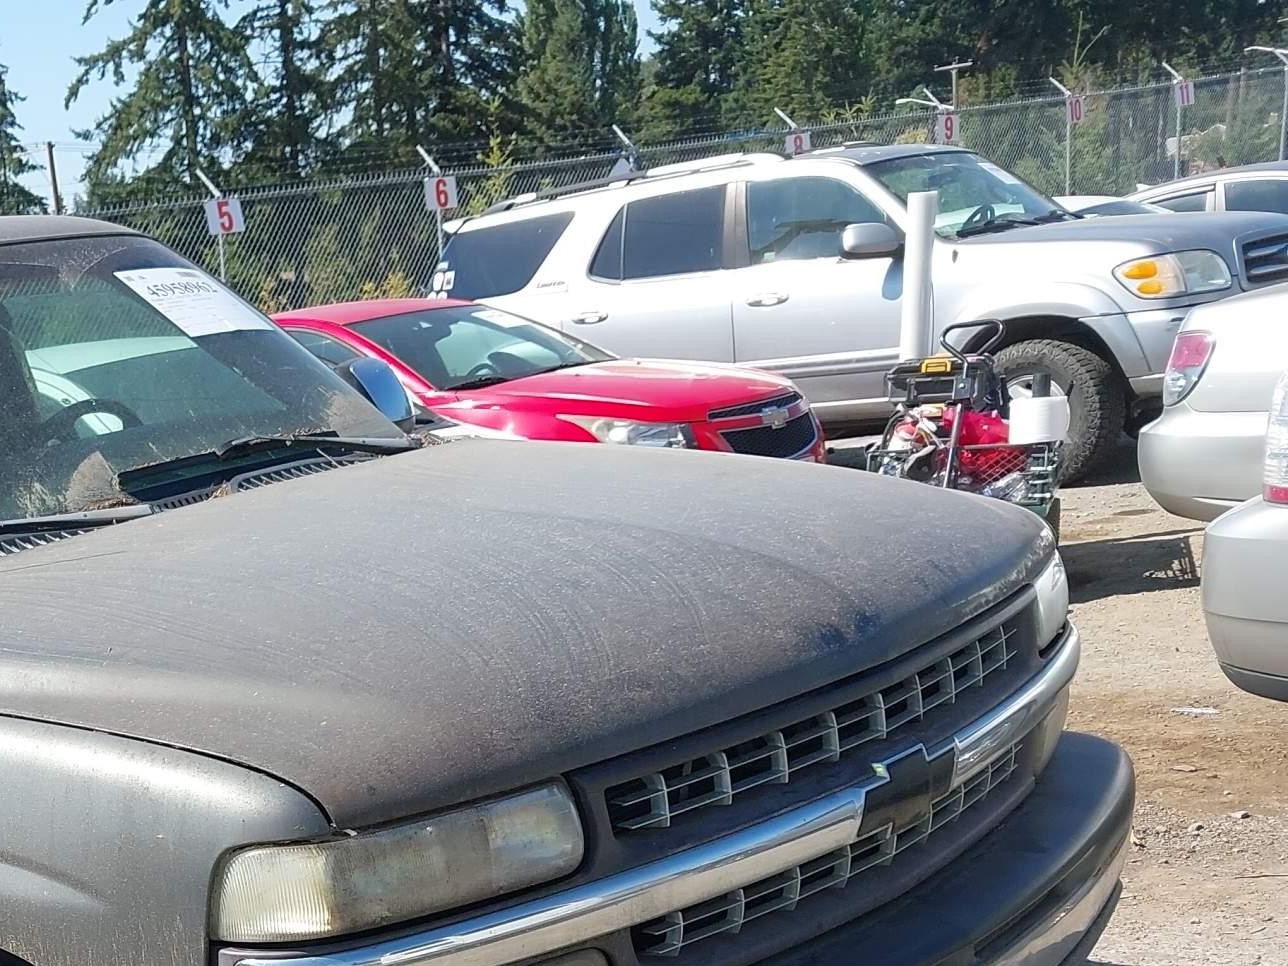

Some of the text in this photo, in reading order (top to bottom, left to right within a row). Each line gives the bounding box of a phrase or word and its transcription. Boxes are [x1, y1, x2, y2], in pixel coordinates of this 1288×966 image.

[1179, 83, 1190, 105] 11
[1069, 98, 1081, 121] 10
[944, 116, 954, 140] 9
[435, 178, 449, 208] 6
[216, 200, 234, 233] 5
[146, 280, 218, 298] 45958962
